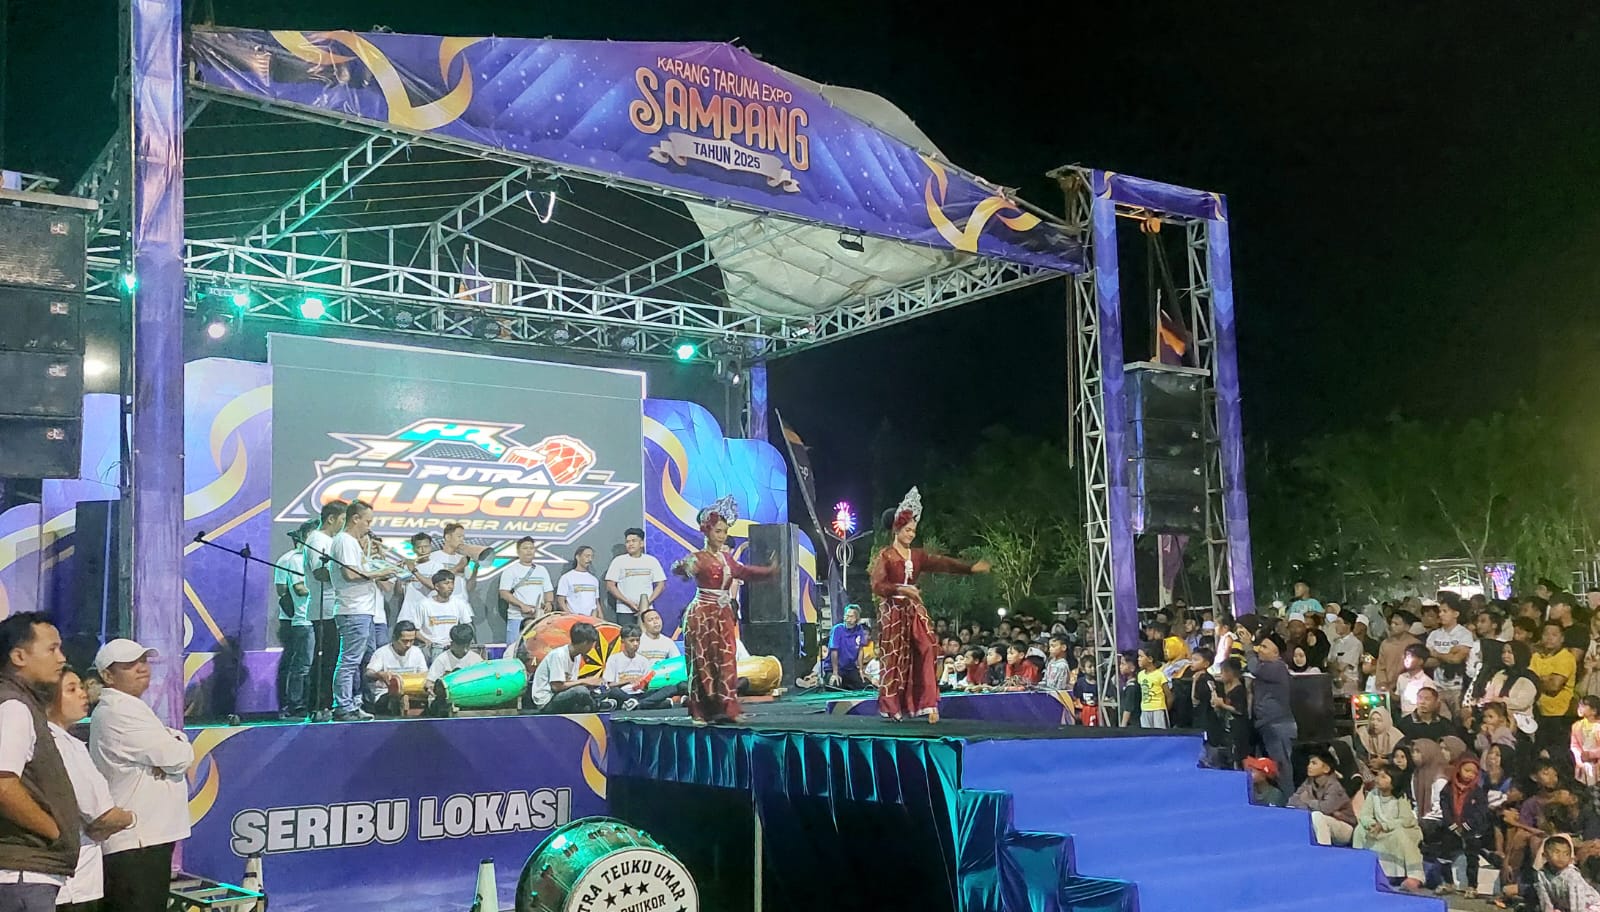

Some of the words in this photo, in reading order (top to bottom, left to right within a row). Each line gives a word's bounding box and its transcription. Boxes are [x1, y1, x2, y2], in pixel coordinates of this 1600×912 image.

[657, 56, 710, 88] KARANG
[713, 68, 760, 100] TARUNA
[762, 84, 792, 104] EXPO
[629, 67, 810, 171] SAMPANG
[693, 141, 731, 165] TAHUN
[734, 150, 761, 169] 2025
[416, 464, 550, 486] PUTRA
[370, 516, 500, 531] TEMPORER
[504, 520, 569, 533] MUSIC
[230, 798, 409, 858] SERIBU
[418, 787, 572, 841] LOKASI
[577, 884, 603, 912] TRA
[600, 859, 653, 885] TEUKU
[654, 863, 686, 902] UMAR
